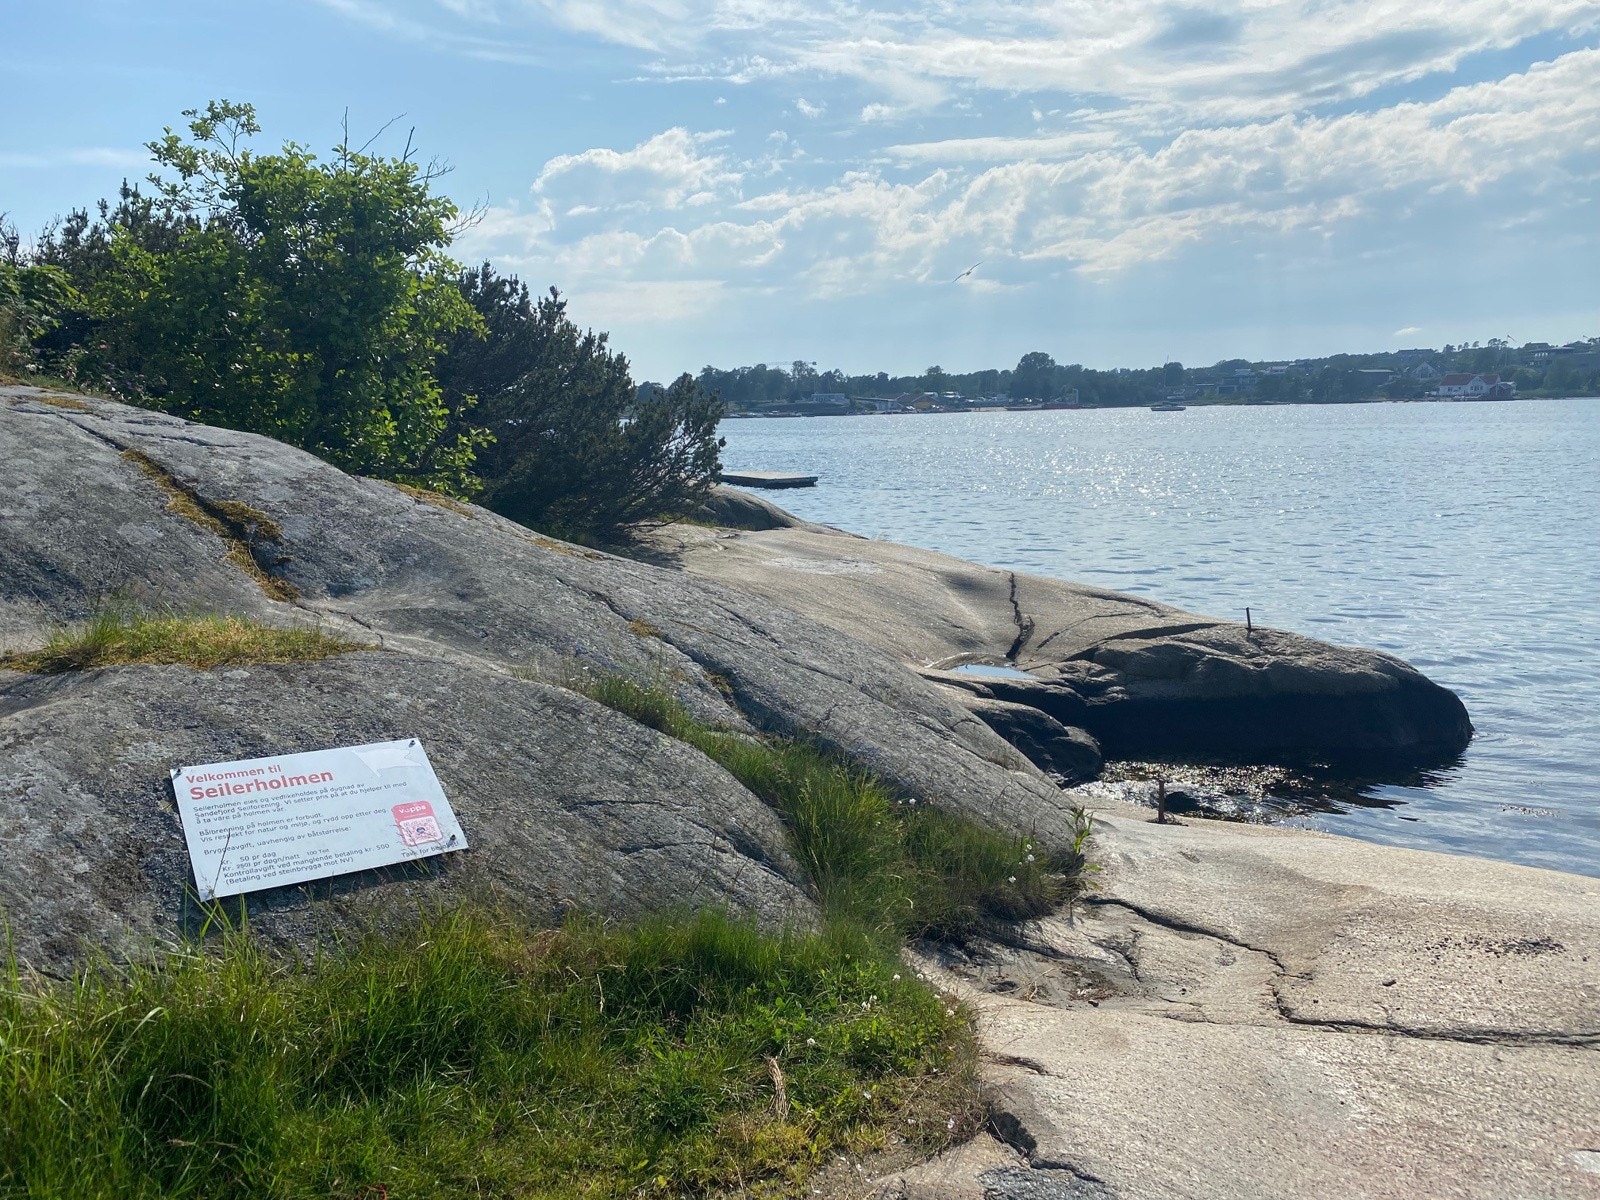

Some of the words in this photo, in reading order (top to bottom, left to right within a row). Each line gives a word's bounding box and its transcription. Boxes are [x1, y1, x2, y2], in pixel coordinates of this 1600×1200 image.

[186, 768, 265, 783] Velkommen
[267, 764, 281, 773] til
[190, 771, 333, 800] Seilerholmen
[193, 801, 241, 812] Seilerholmen
[271, 790, 318, 801] vedlikeholdes
[319, 787, 328, 795] på
[329, 783, 355, 792] dugnad
[195, 807, 235, 819] Sandefjord
[330, 791, 339, 799] på
[359, 786, 383, 794] hjelper
[232, 812, 242, 820] på
[243, 809, 270, 817] holmen
[323, 815, 339, 824] rydd
[199, 825, 245, 837] Bålbrenning
[246, 822, 255, 831] på
[258, 819, 284, 827] holmen
[257, 835, 295, 847] uavhengig
[307, 826, 352, 838] båtstørrelse:
[224, 864, 275, 879] Kontrollavgift
[277, 861, 291, 869] ved
[293, 854, 333, 866] manglende
[334, 849, 363, 858] betaling
[263, 853, 300, 865] døgn/natt
[225, 875, 261, 886] (Betaling
[278, 863, 322, 875] steinbrygga
